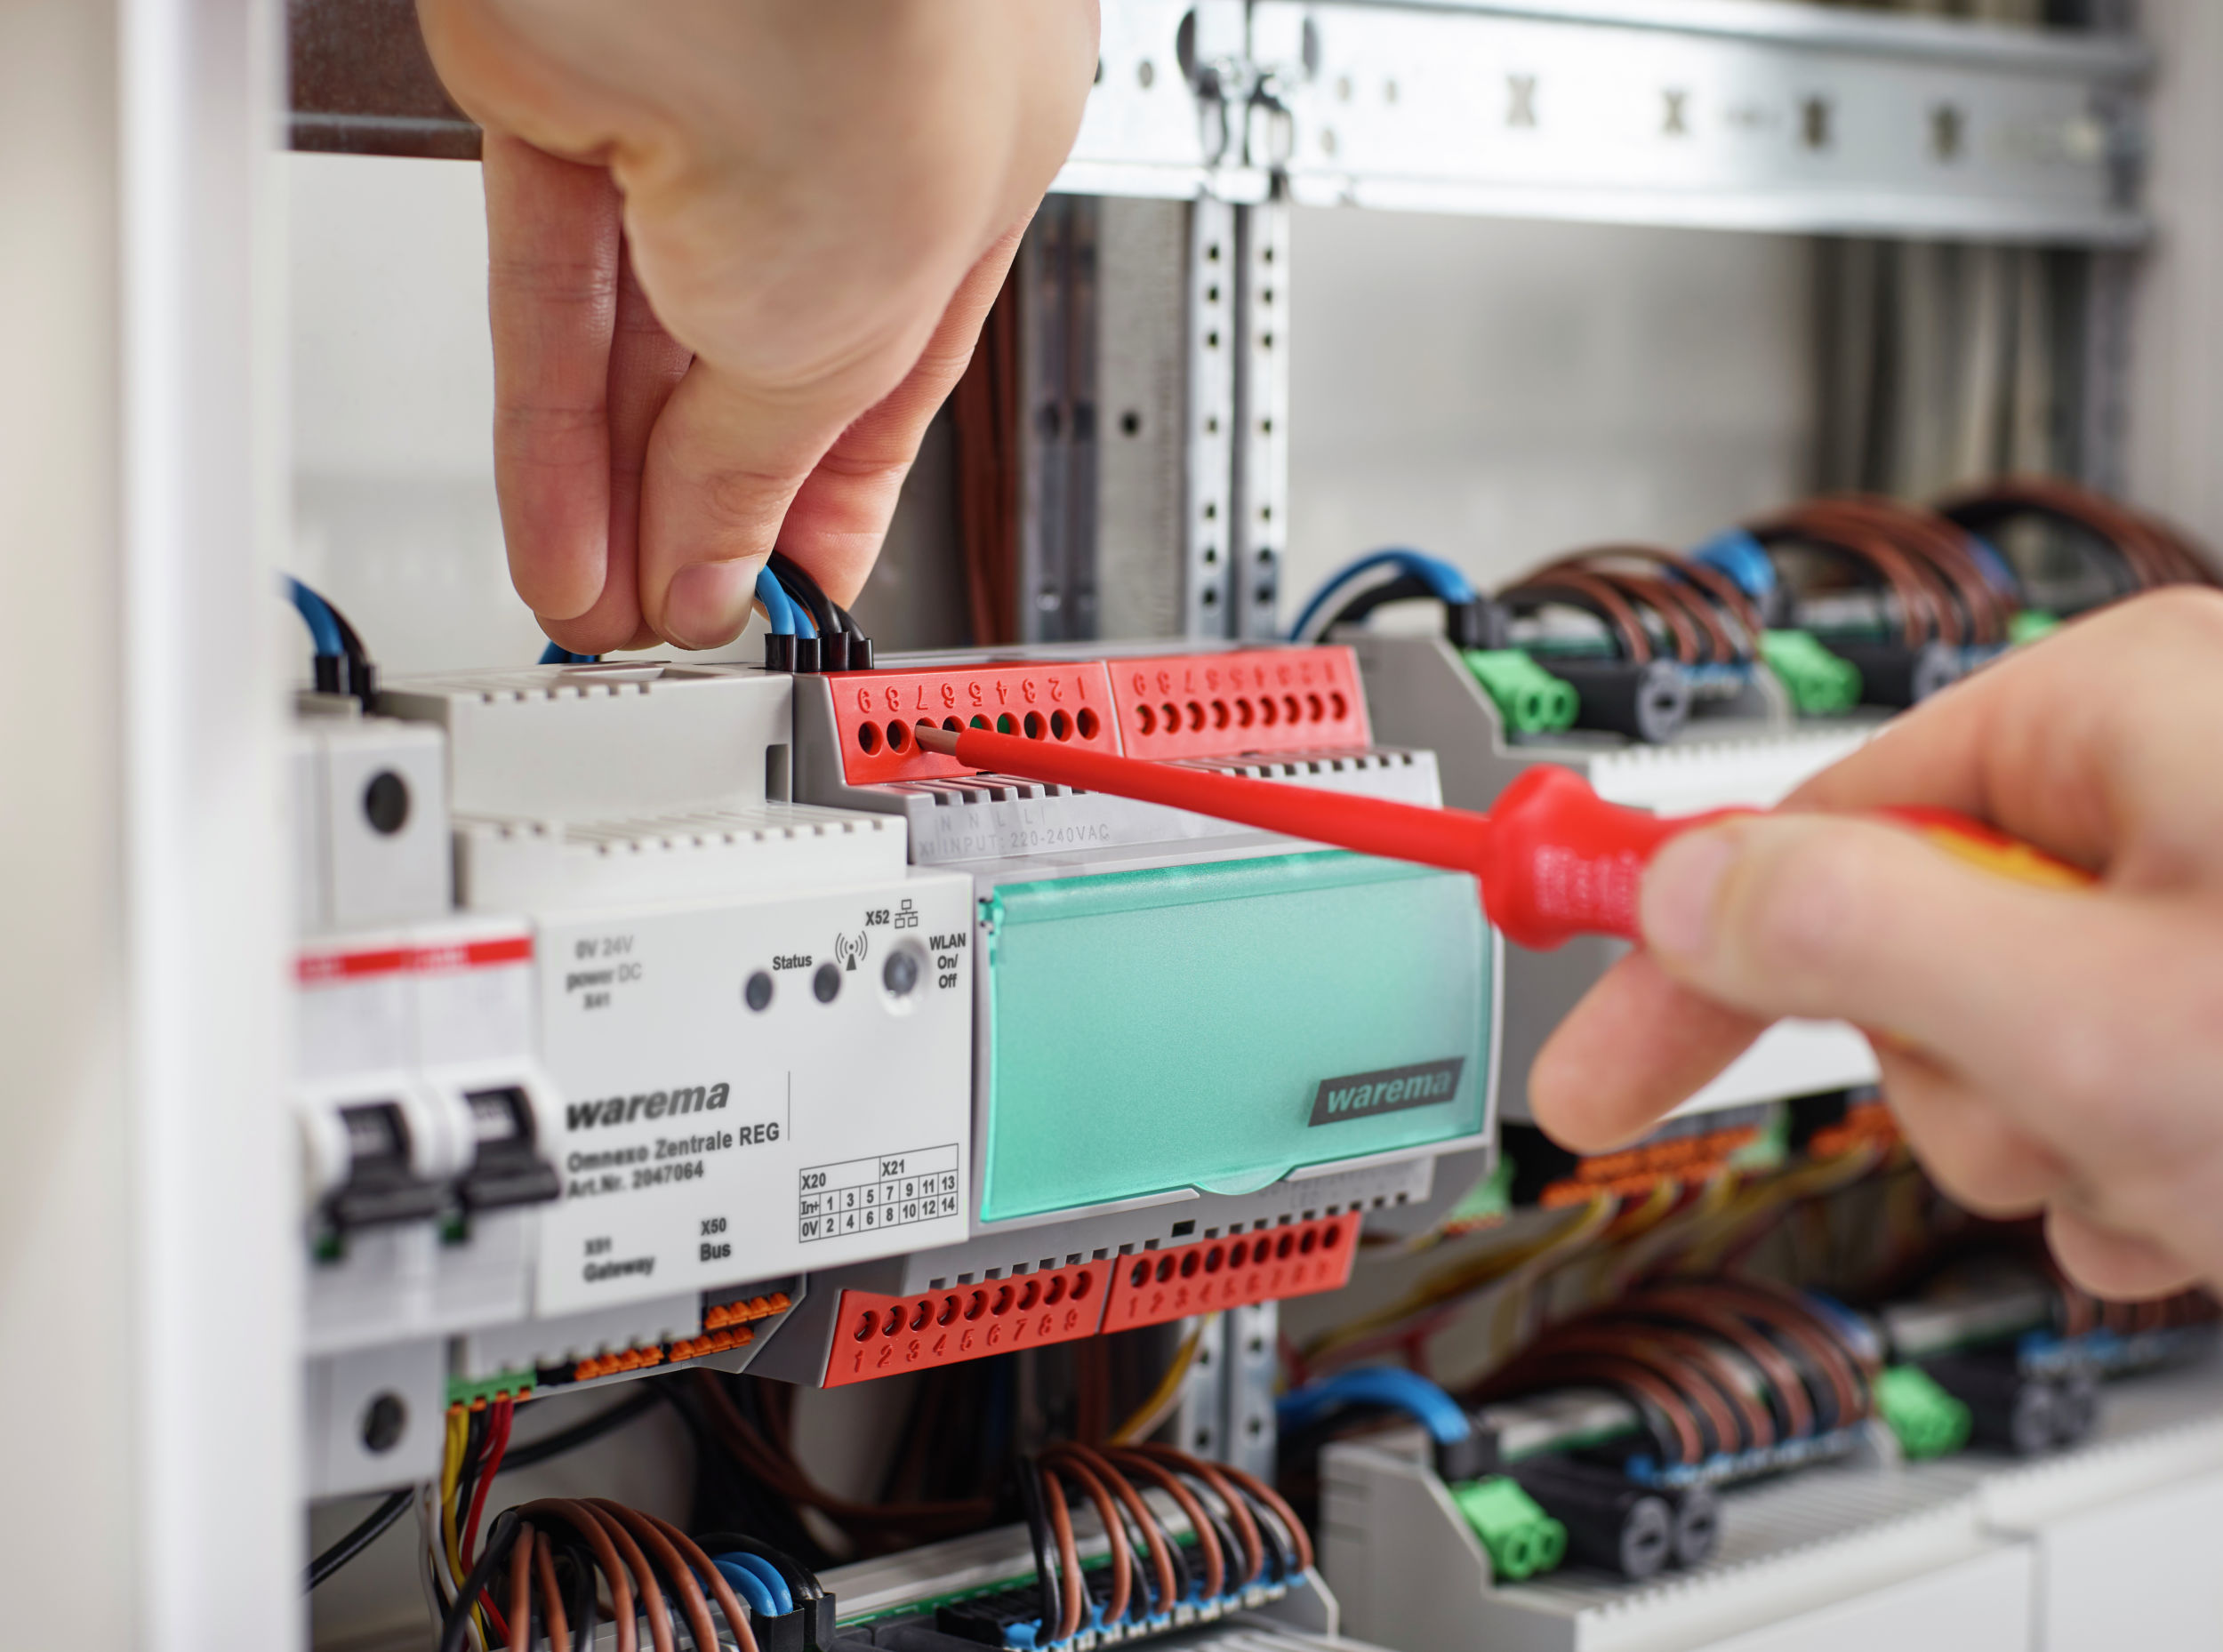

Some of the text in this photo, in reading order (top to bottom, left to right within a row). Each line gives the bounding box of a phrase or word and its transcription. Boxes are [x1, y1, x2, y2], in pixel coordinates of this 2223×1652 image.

[865, 910, 889, 926] X52
[929, 933, 966, 950] WLAN
[619, 962, 641, 982] DC
[773, 954, 812, 971] Status
[937, 953, 958, 971] On/
[938, 973, 957, 989] Off
[1328, 1071, 1452, 1113] warema
[566, 1081, 730, 1132] warema
[654, 1131, 733, 1160] Zentrale
[739, 1122, 779, 1147] REG
[632, 1159, 704, 1189] 2047064
[802, 1159, 905, 1190] X20 X21
[801, 1175, 955, 1215] In+ 1 3 5 7 9 11 13
[701, 1218, 726, 1236] X50
[802, 1196, 955, 1237] 0V 2 4 6 8 10 12 14
[700, 1243, 731, 1262] Bus
[855, 1309, 1078, 1372] 1 2 3 4 5 6 7 8 9
